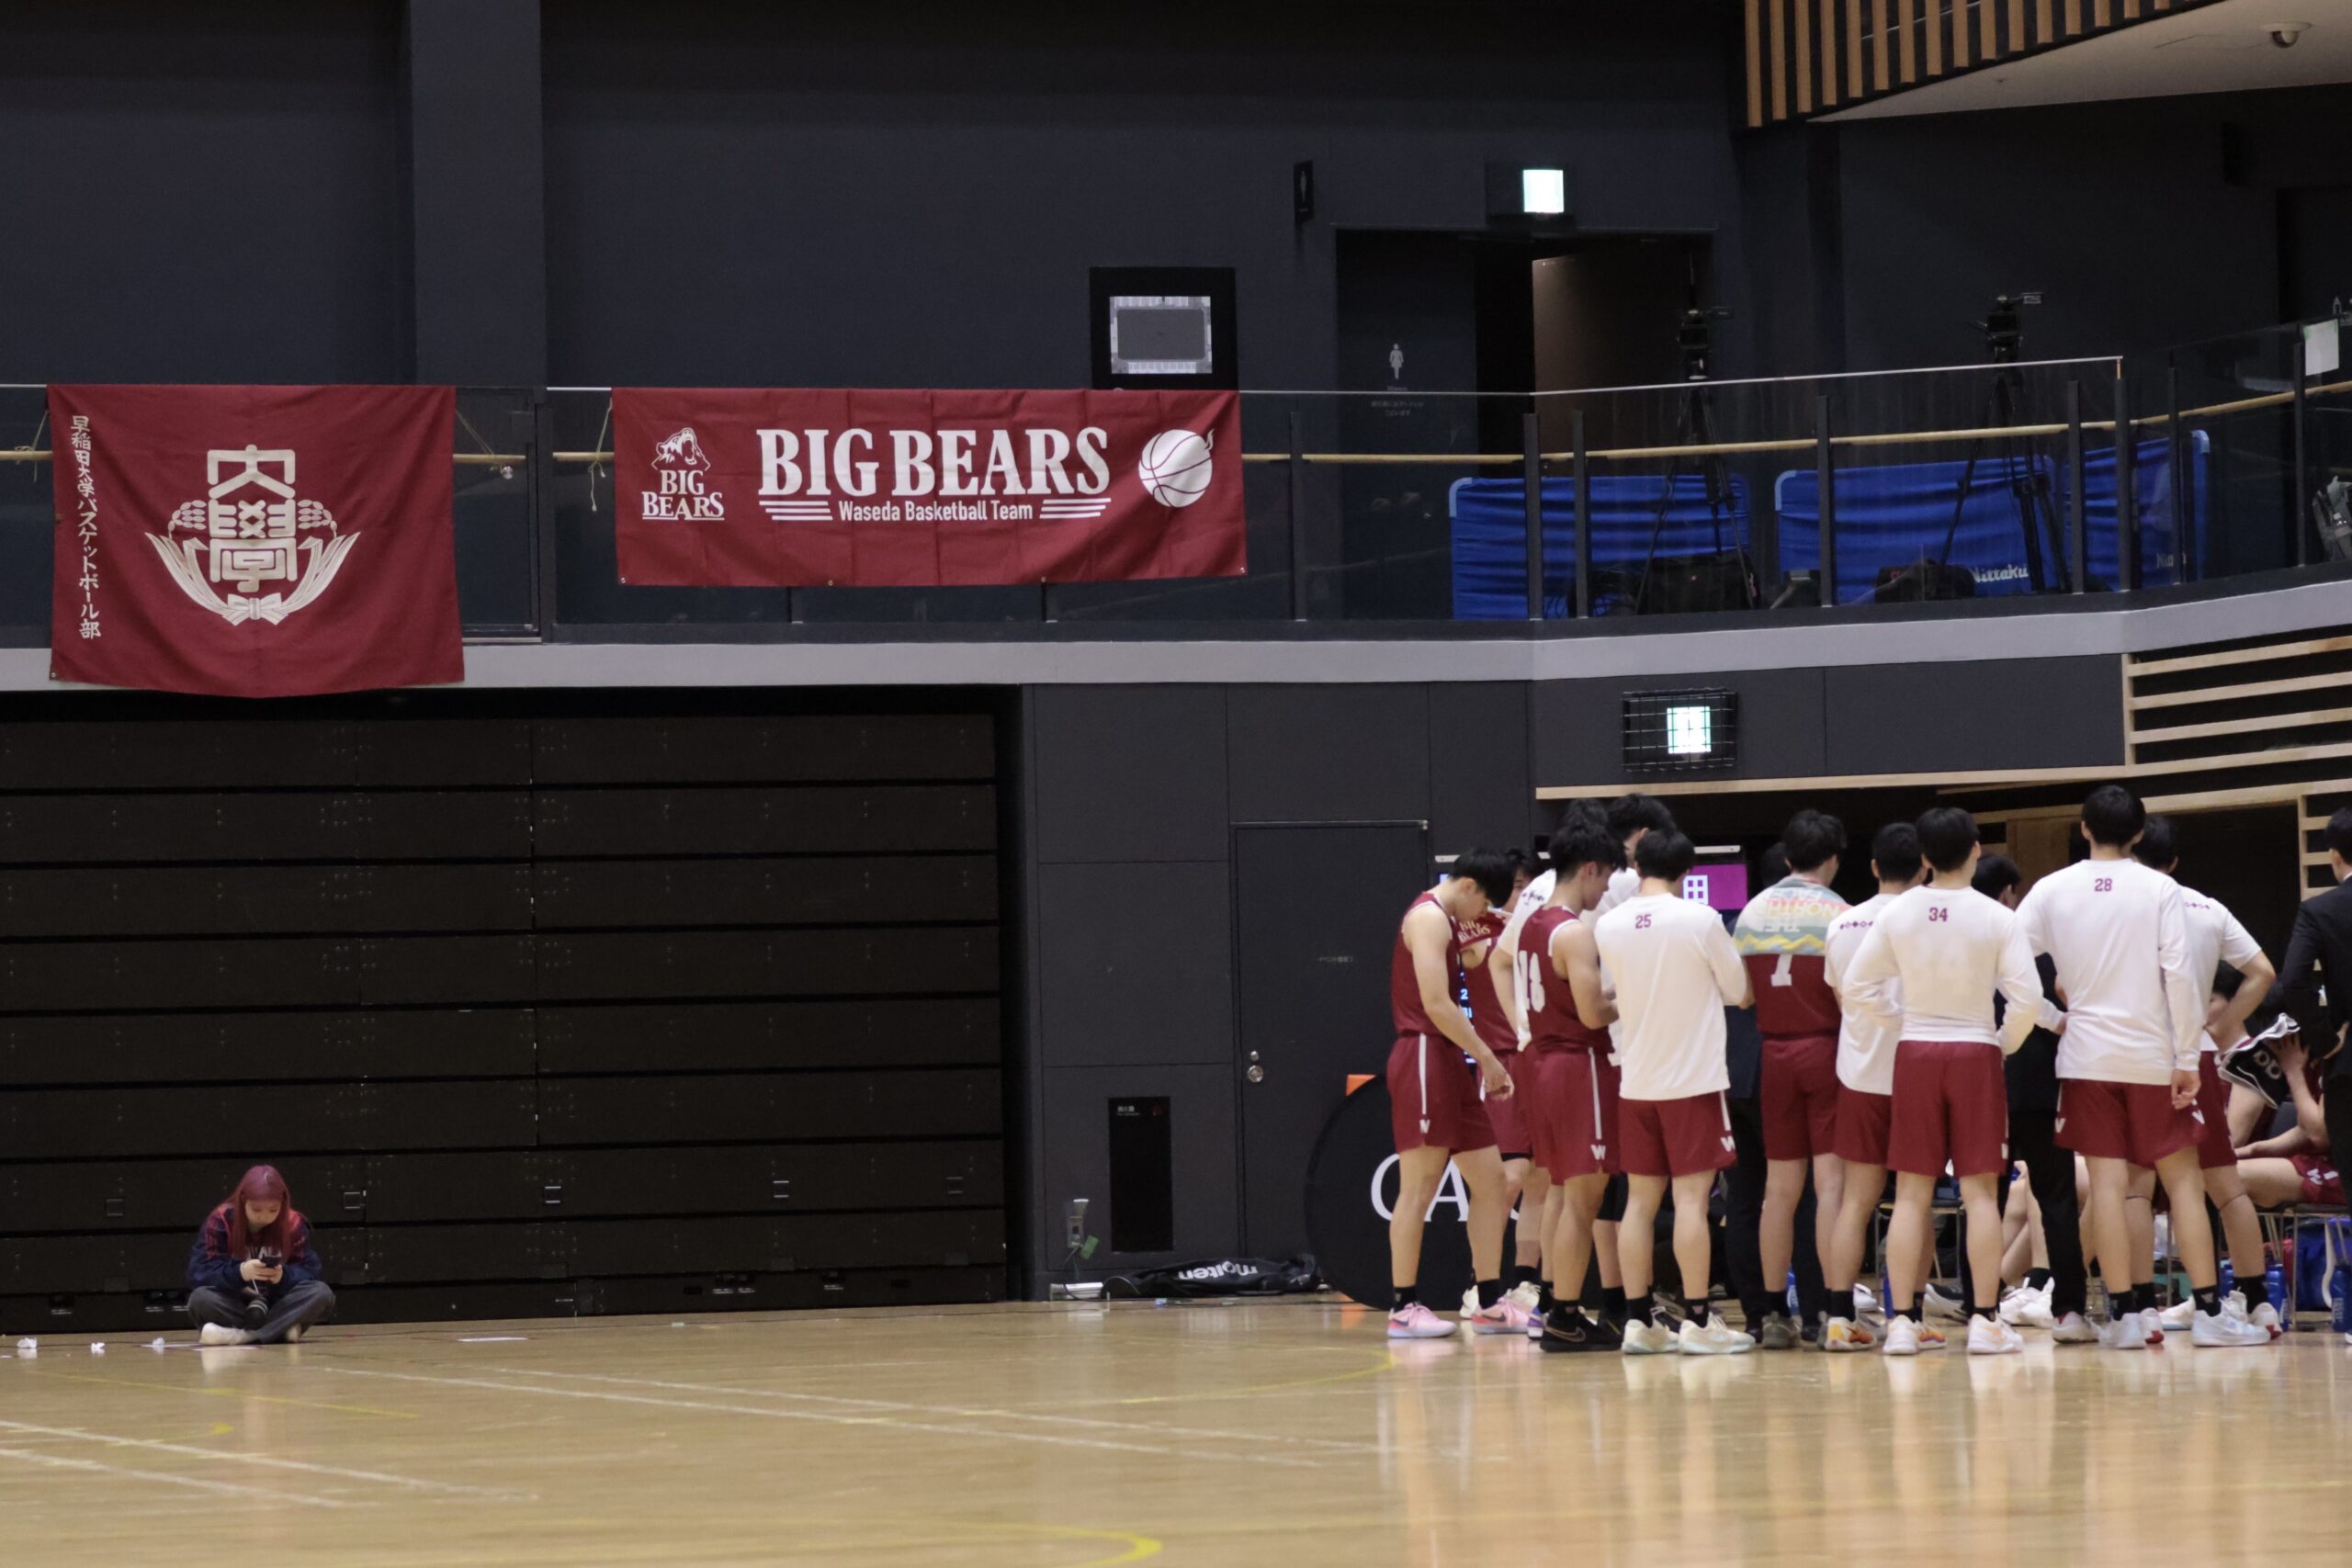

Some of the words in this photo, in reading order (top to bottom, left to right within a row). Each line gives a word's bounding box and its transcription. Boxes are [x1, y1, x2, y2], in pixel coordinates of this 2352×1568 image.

[756, 428, 879, 497] BIG
[889, 426, 1110, 496] BEARS
[660, 469, 705, 495] BIG
[641, 491, 724, 520] BEARS
[838, 500, 900, 522] Waseda
[904, 500, 988, 521] Basketball
[989, 500, 1034, 521] Team
[71, 415, 102, 639] 早稲田大学バスケットボール部
[2095, 878, 2112, 892] 28
[1634, 914, 1651, 929] 25
[1929, 908, 1948, 921] 34
[1590, 1144, 1606, 1160] W
[1178, 1260, 1259, 1280] molten
